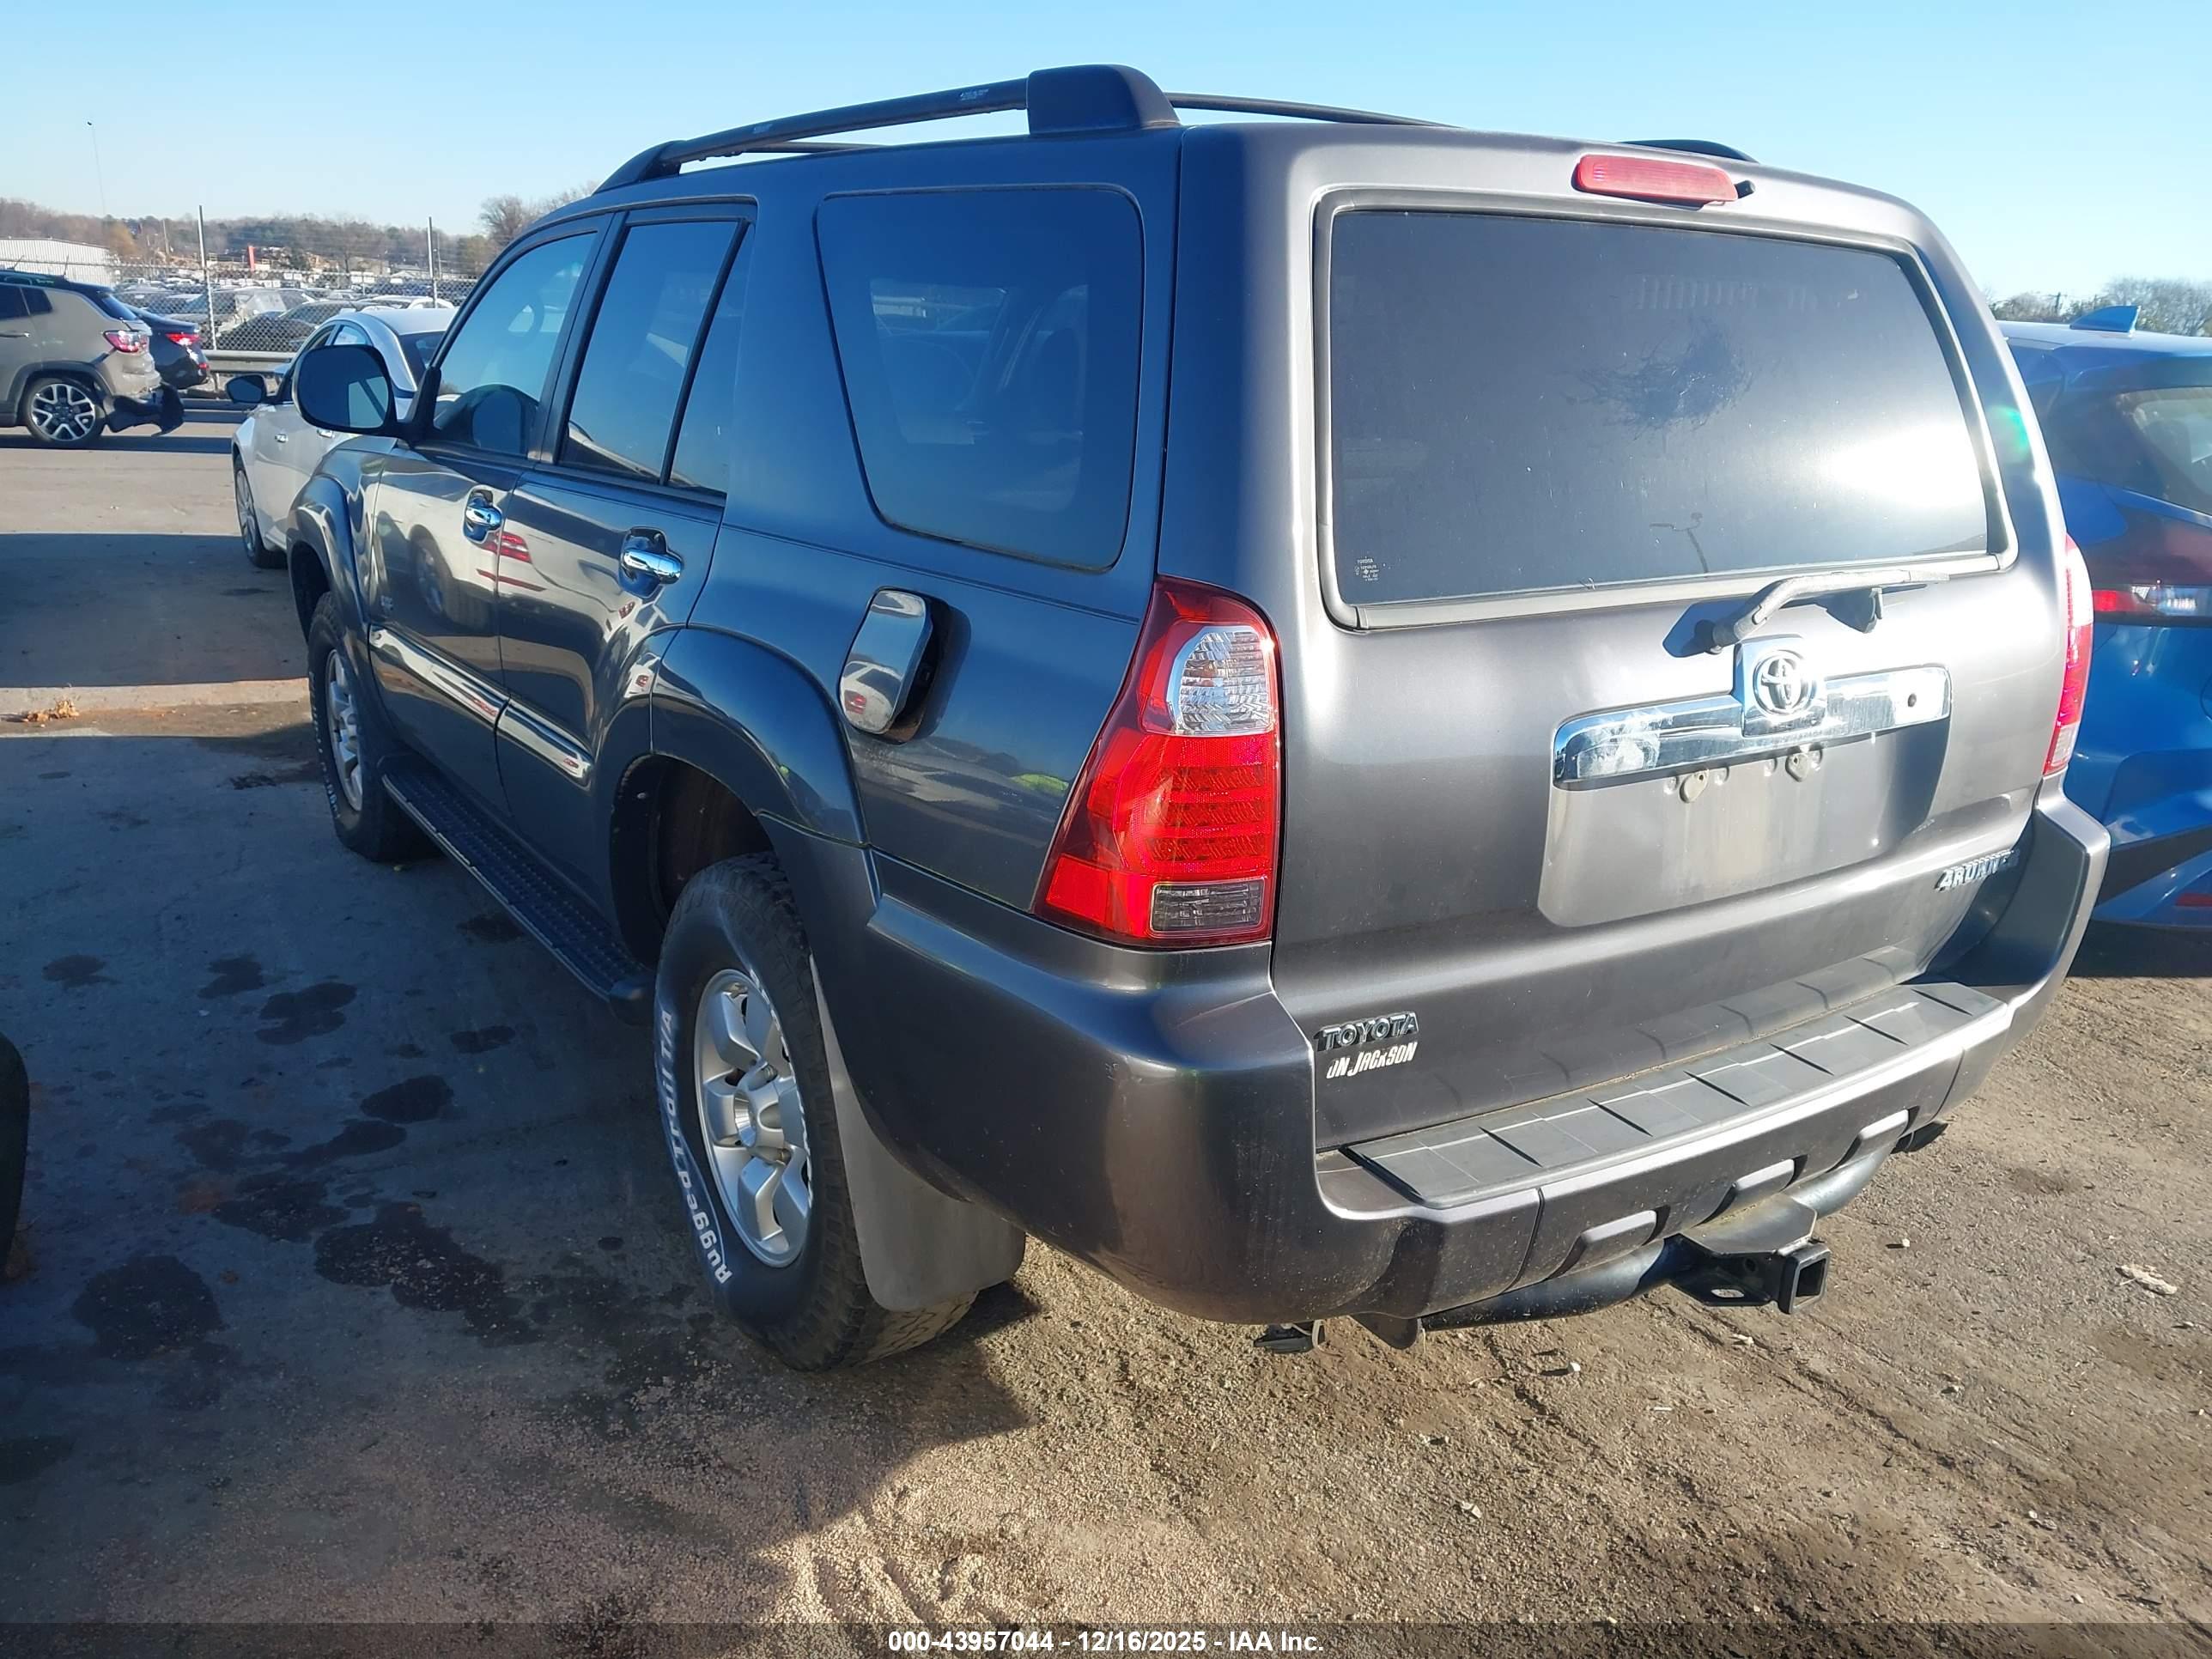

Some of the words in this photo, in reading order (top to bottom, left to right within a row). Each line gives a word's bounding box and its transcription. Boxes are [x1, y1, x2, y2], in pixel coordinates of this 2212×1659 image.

[659, 1009, 674, 1060] T/A
[1318, 1012, 1419, 1051] TOYOTA
[1346, 1040, 1419, 1078] JACKSON
[661, 1067, 687, 1159] Trail
[677, 1170, 734, 1285] Rugged
